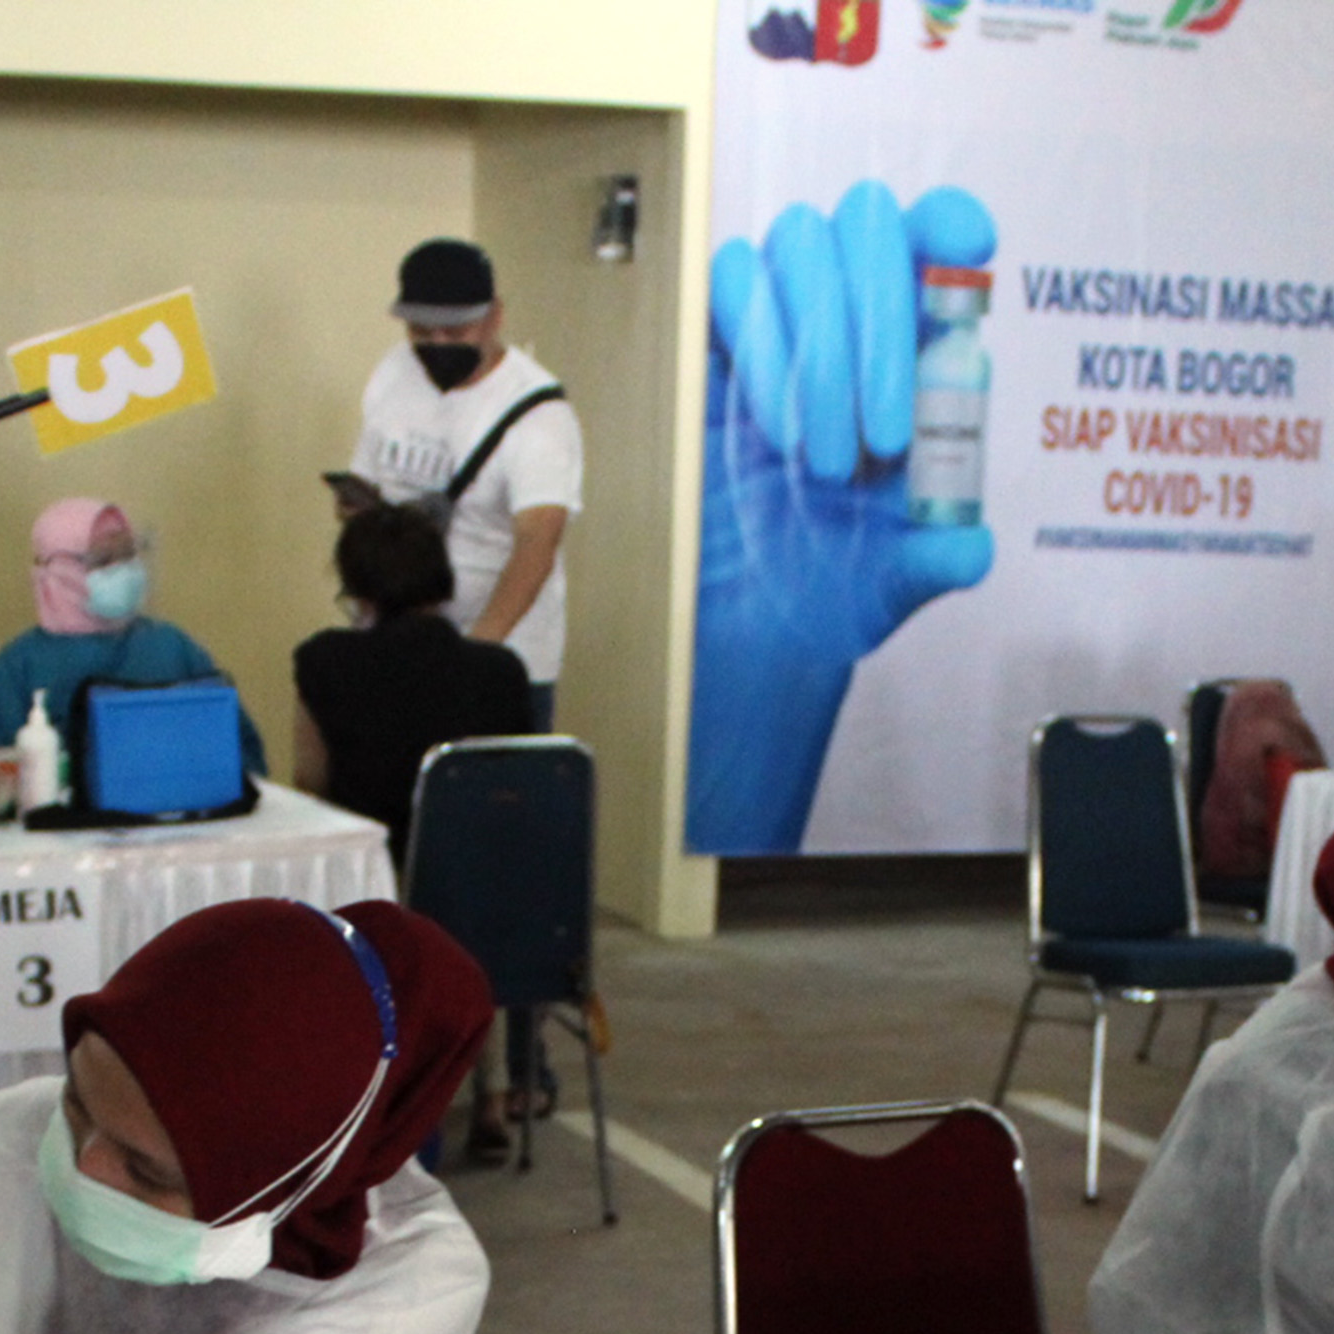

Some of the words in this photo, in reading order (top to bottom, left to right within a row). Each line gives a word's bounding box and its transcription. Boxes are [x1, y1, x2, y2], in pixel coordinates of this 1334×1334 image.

[1022, 264, 1210, 321] VAKSINASI
[47, 320, 184, 424] 3
[1077, 342, 1167, 391] KOTA
[1175, 347, 1297, 399] BOGOR
[1040, 404, 1117, 453] SIAP
[1102, 468, 1255, 519] COVID-19
[15, 955, 55, 1008] 3
